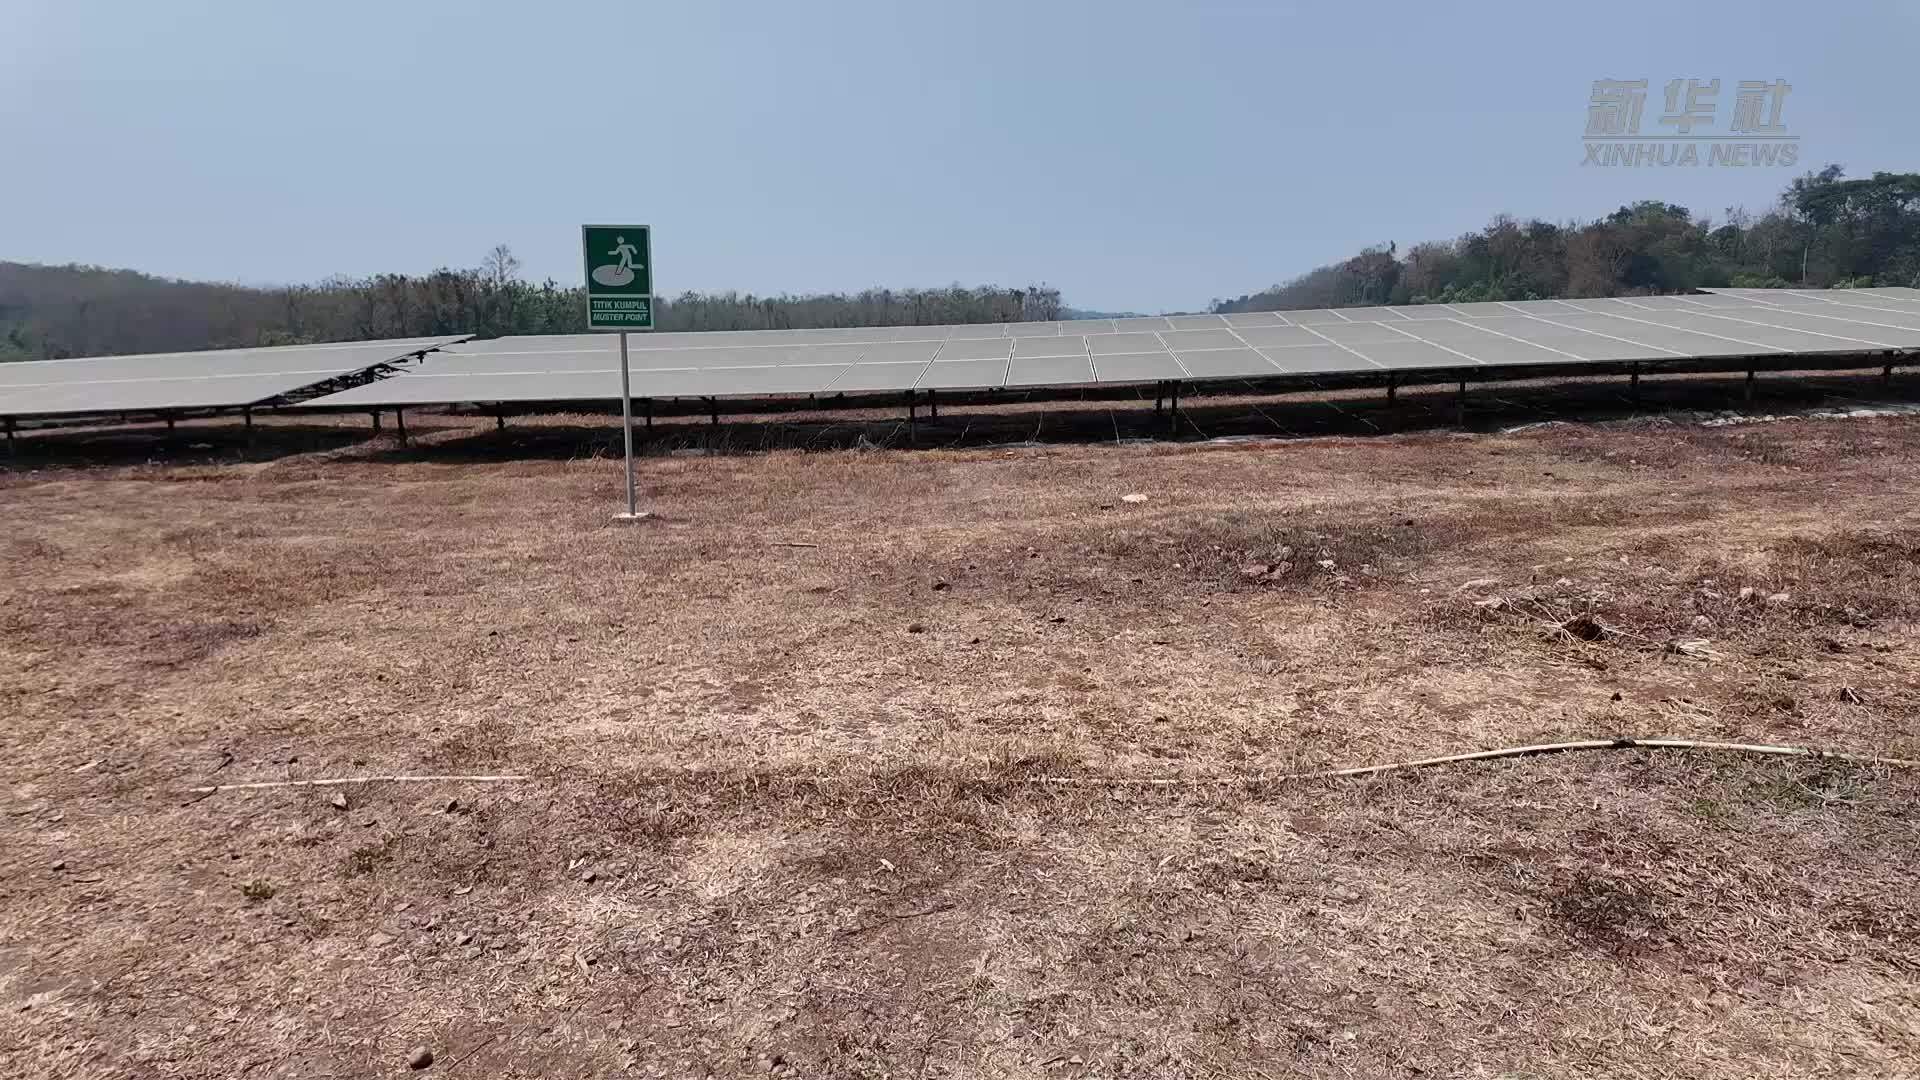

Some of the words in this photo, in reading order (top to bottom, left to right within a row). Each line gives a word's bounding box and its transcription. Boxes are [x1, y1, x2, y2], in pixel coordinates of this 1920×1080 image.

[592, 300, 613, 310] TITIK
[614, 300, 647, 310] KUMPUL
[593, 313, 624, 321] MUSTER
[625, 313, 648, 321] POINT
